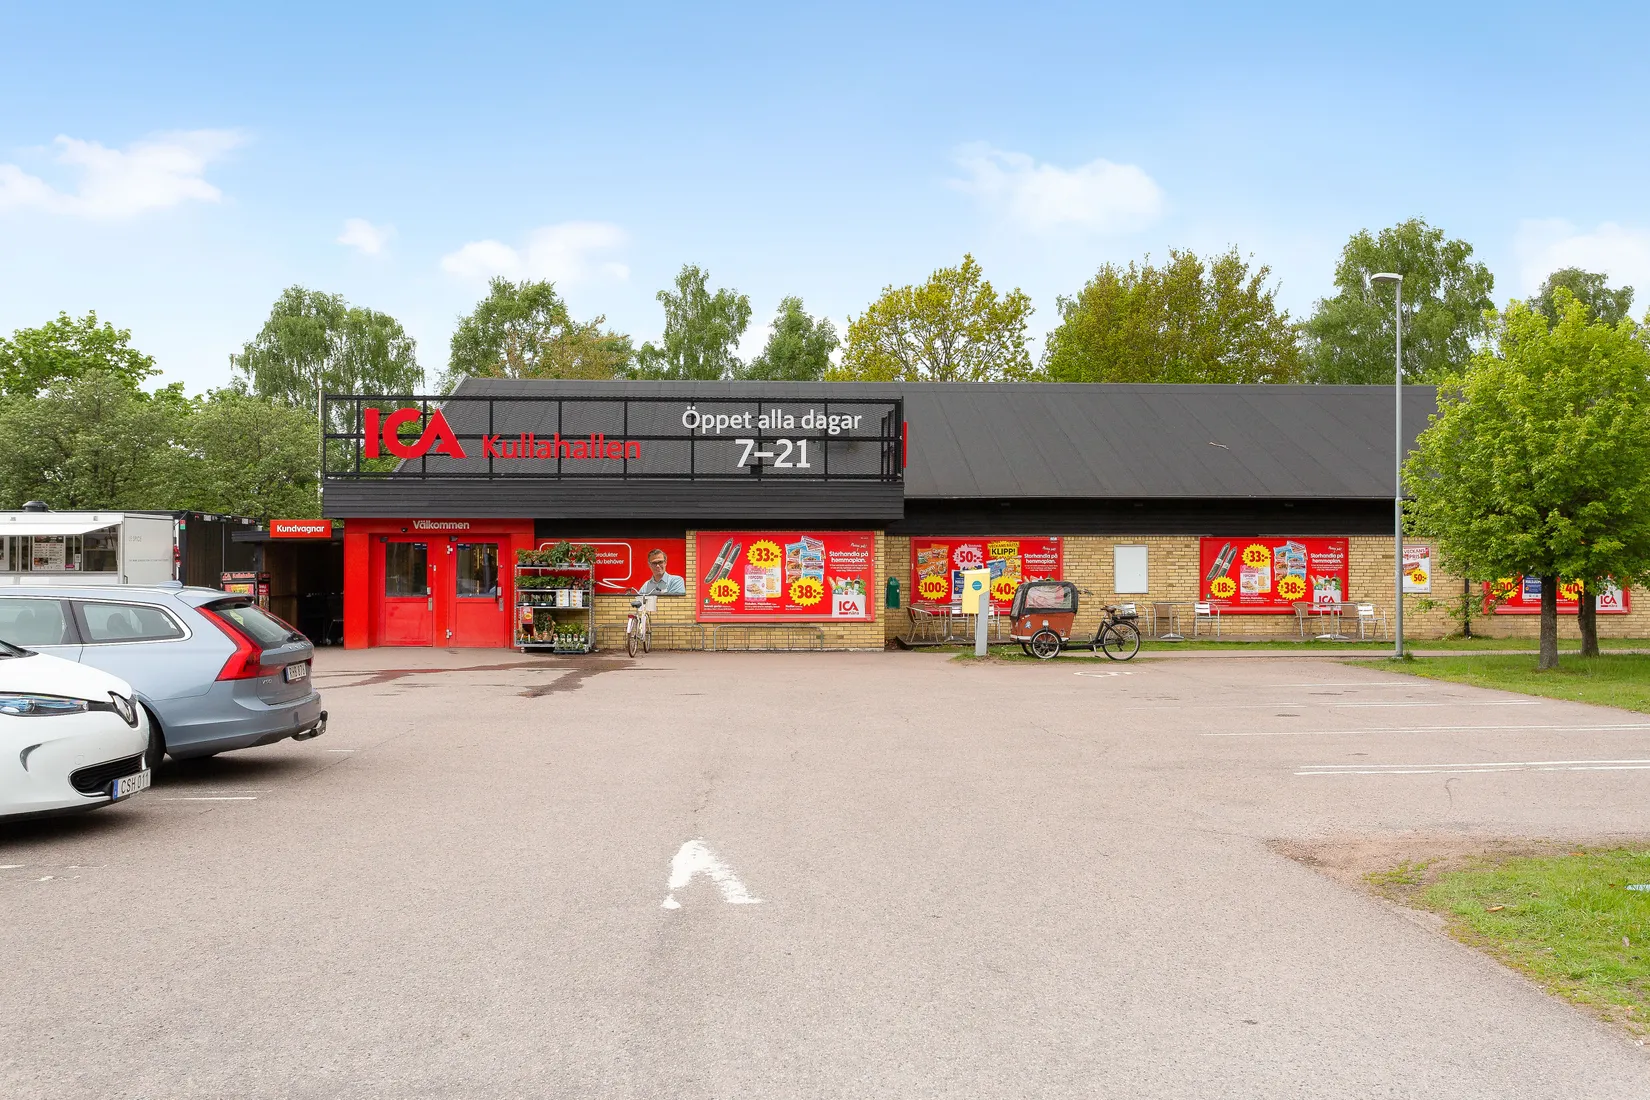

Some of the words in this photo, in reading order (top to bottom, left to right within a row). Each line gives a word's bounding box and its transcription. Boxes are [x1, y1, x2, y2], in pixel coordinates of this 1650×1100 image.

[682, 406, 751, 434] Öppet
[758, 409, 795, 429] alla
[801, 409, 862, 434] dagar
[364, 408, 467, 459] ICA
[482, 432, 641, 460] Kullahallen
[276, 524, 325, 534] Kundvagnar
[413, 520, 470, 530] Välkommen
[861, 550, 869, 558] på
[1319, 595, 1335, 603] ICA
[1600, 595, 1617, 604] ICA
[839, 601, 859, 611] ICA
[121, 777, 136, 794] CSH
[137, 771, 149, 789] 011
